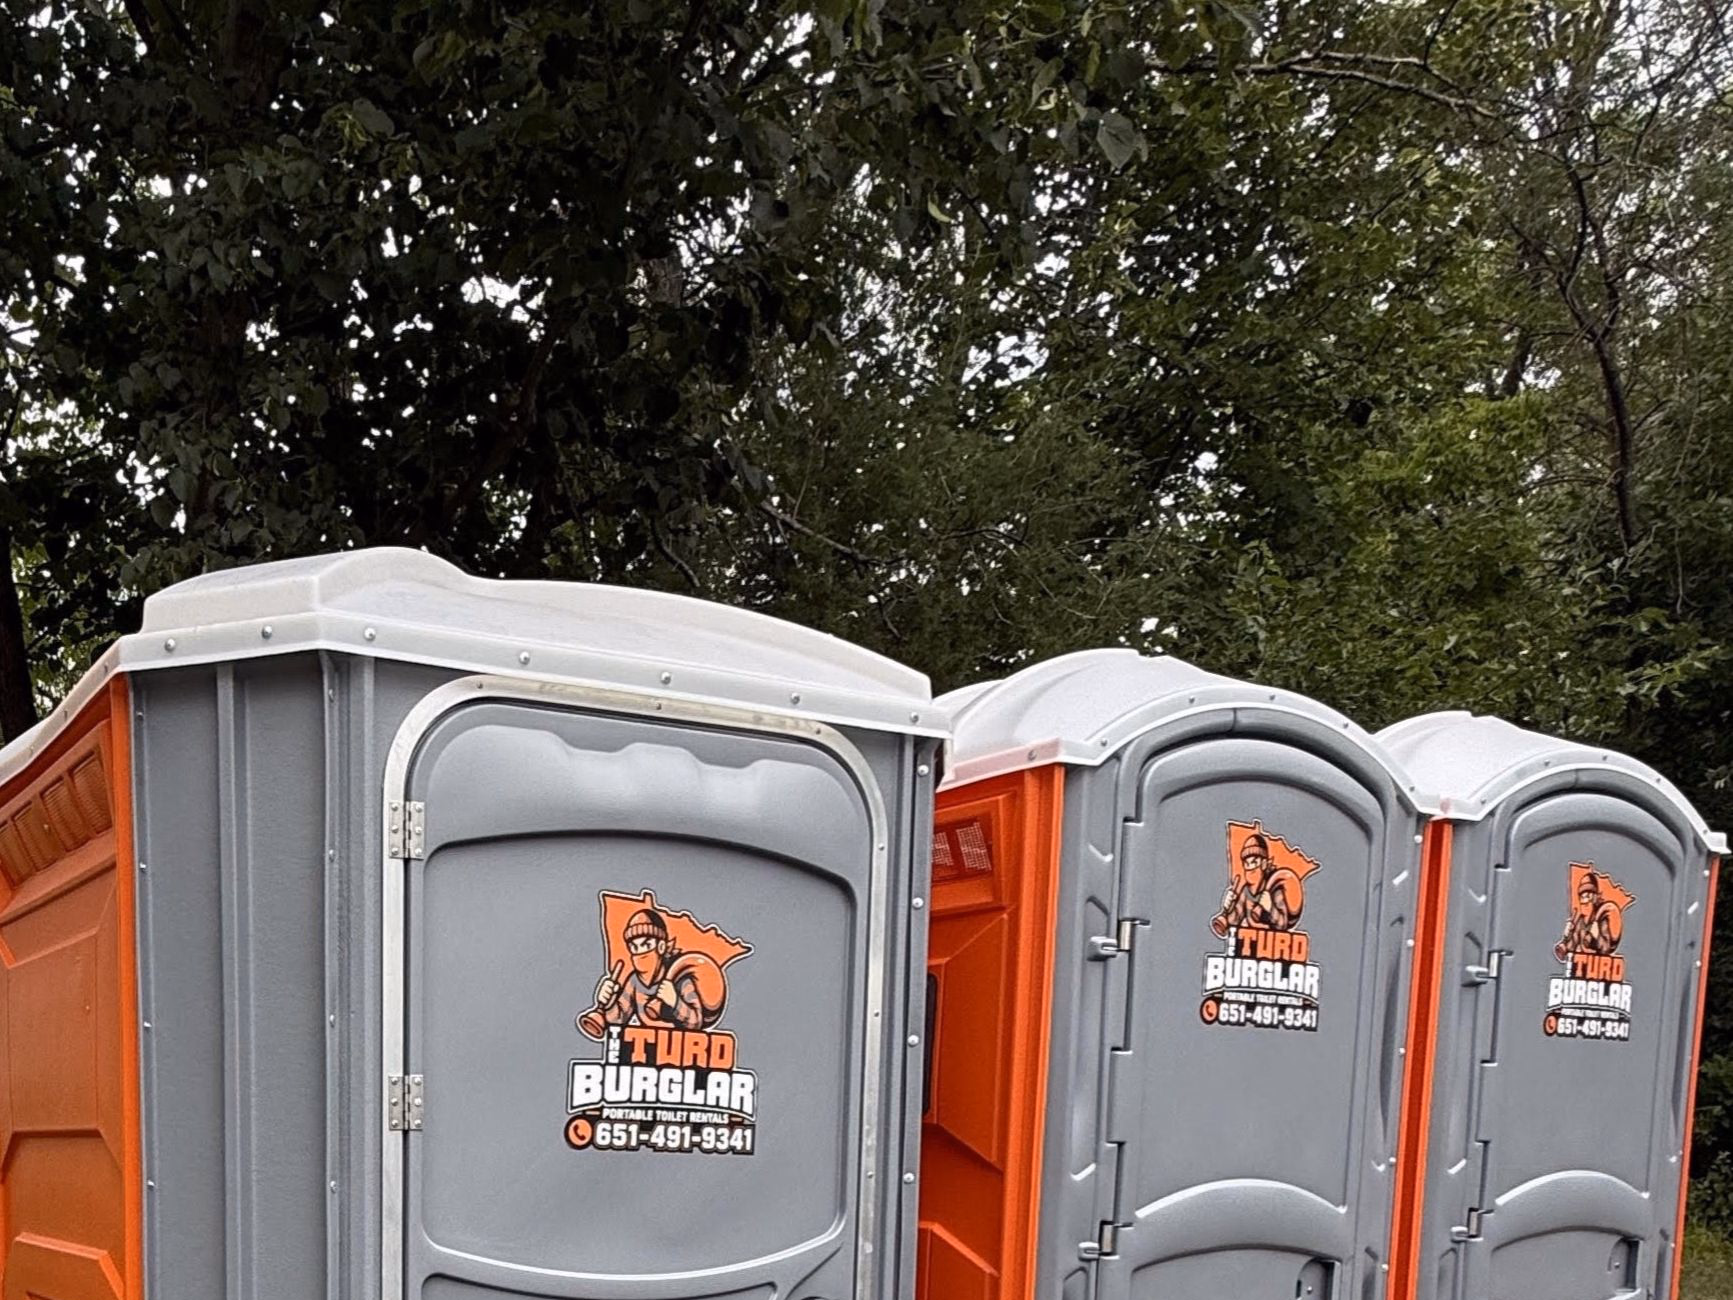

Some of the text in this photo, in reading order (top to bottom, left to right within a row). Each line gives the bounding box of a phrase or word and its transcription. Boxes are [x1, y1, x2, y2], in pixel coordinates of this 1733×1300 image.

[1238, 927, 1308, 962] TURD
[1206, 957, 1320, 1000] BURGLAR
[1574, 953, 1624, 982] TURD
[1548, 978, 1632, 1012] BURGLAR
[1219, 1003, 1317, 1028] 651-491-9341
[1557, 1017, 1630, 1037] 651-491-9341
[609, 1026, 621, 1063] THE
[624, 1027, 734, 1069] TURD
[571, 1064, 755, 1115] BURGLAR
[602, 1108, 729, 1124] PORTABLE TOILET RENTALS
[595, 1122, 752, 1151] 651-491-9341
